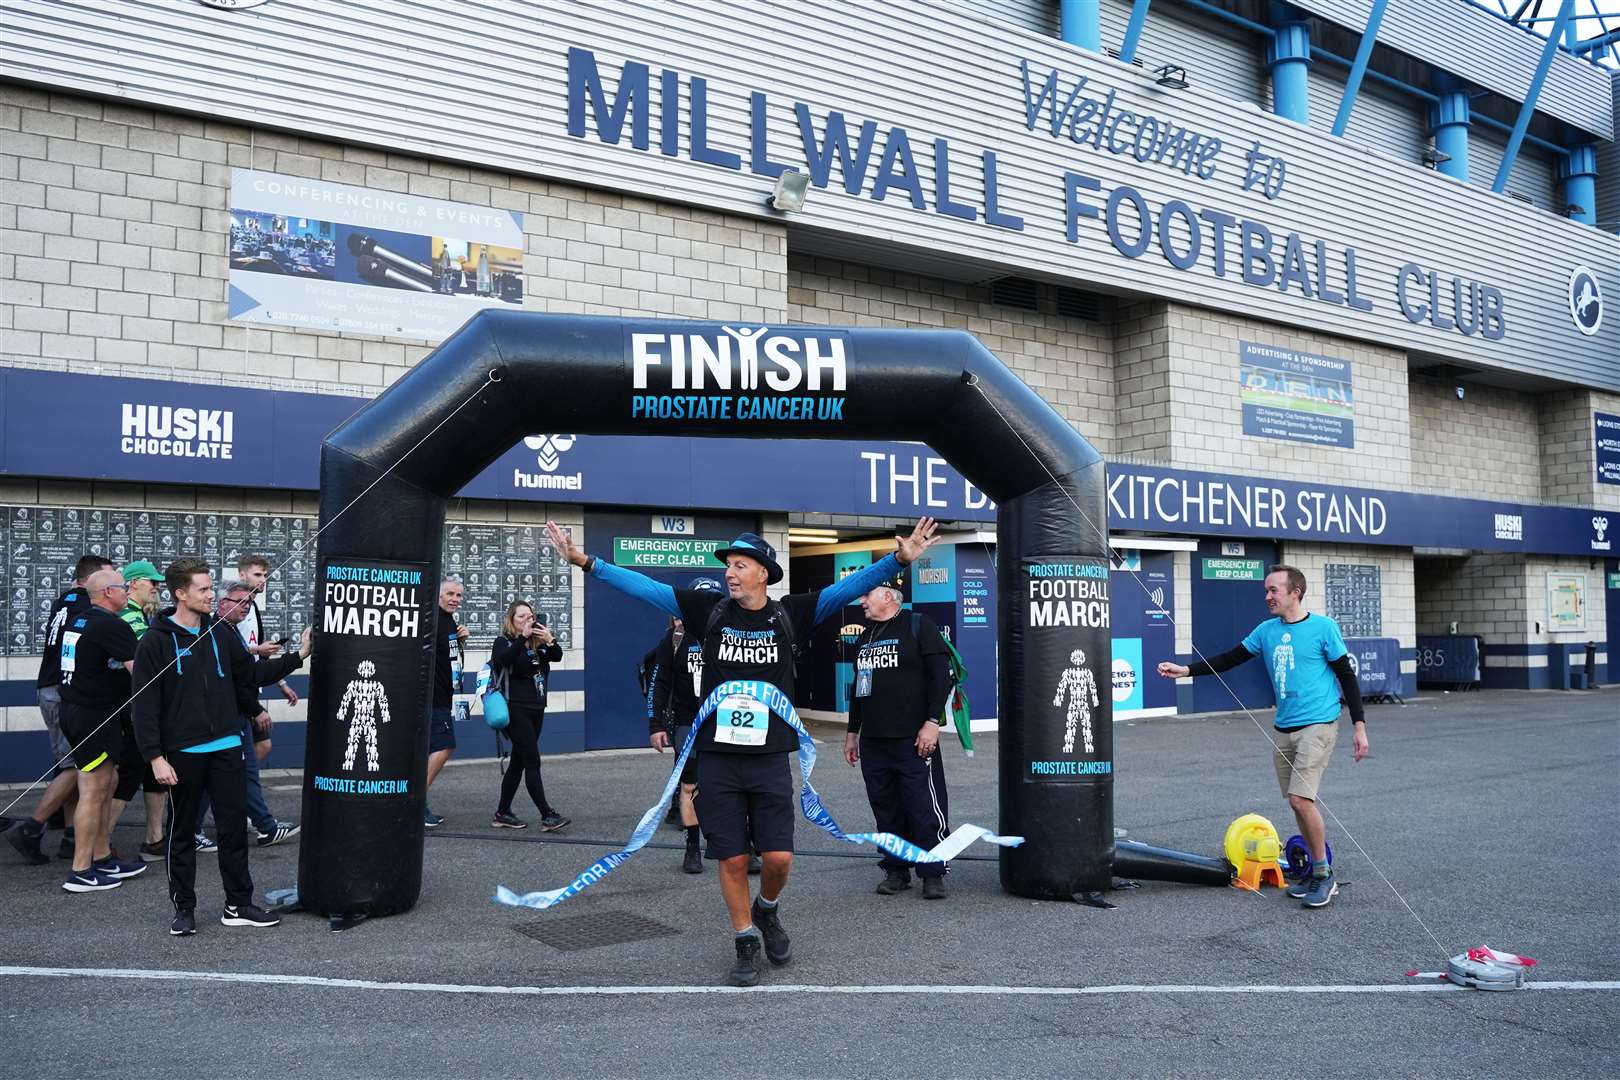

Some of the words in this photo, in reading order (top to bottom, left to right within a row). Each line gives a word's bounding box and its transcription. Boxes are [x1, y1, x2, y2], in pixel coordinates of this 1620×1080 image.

[1021, 58, 1221, 180] Welcome
[1243, 140, 1286, 200] to
[568, 46, 1024, 231] MILLWALL
[1064, 171, 1373, 311] FOOTBALL
[1399, 263, 1506, 340] CLUB
[254, 180, 409, 215] CONFERENCING
[417, 206, 428, 217] &
[437, 208, 503, 228] EVENTS
[631, 326, 847, 392] FINISH
[1247, 346, 1292, 361] ADVERTISING
[1301, 356, 1345, 370] SPONSORSHIP
[1290, 363, 1300, 371] THE
[632, 395, 732, 419] PROSTATE
[737, 396, 814, 420] CANCER
[817, 397, 845, 420] UK
[122, 403, 233, 442] HUSKI
[121, 437, 232, 459] CHOCOLATE
[514, 469, 582, 490] hummel
[860, 451, 947, 508] THE
[1107, 473, 1287, 529] KITCHENER
[1296, 490, 1386, 535] STAND
[661, 517, 685, 532] W3
[1495, 514, 1522, 532] HUSKI
[1495, 531, 1522, 541] CHOCOLATE
[1591, 540, 1611, 550] hummel
[620, 540, 691, 552] EMERGENCY
[694, 542, 718, 552] EXIT
[1227, 544, 1240, 554] W5
[634, 553, 662, 564] KEEP
[665, 554, 705, 566] CLEAR
[1207, 560, 1245, 569] EMERGENCY
[1247, 561, 1260, 569] EXIT
[327, 566, 369, 580] PROSTATE
[371, 569, 409, 584] CANCER
[410, 572, 421, 584] UK
[918, 568, 949, 585] MORISON
[1029, 564, 1073, 577] PROSTATE
[1075, 565, 1100, 579] CANCER
[1215, 570, 1231, 578] KEEP
[1233, 571, 1253, 579] CLEAR
[325, 583, 420, 607] FOOTBALL
[1029, 580, 1109, 600] FOOTBALL
[963, 598, 978, 606] FOR
[963, 607, 985, 615] LIONS
[324, 605, 419, 638] MARCH
[1030, 601, 1109, 628] MARCH
[722, 634, 777, 647] FOOTBALL
[718, 644, 778, 663] MARCH
[857, 655, 898, 670] MARCH
[1365, 652, 1377, 660] CLUB
[688, 662, 702, 673] M
[700, 680, 757, 720] MARCH
[762, 686, 788, 716] FOR
[730, 711, 754, 728] 82
[1031, 761, 1076, 774] PROSTATE
[1078, 761, 1105, 774] CANCER
[314, 776, 355, 793] PROSTATE
[358, 780, 395, 794] CANCER
[397, 780, 408, 793] UK
[872, 833, 905, 858] MEN
[572, 864, 607, 891] FOR
